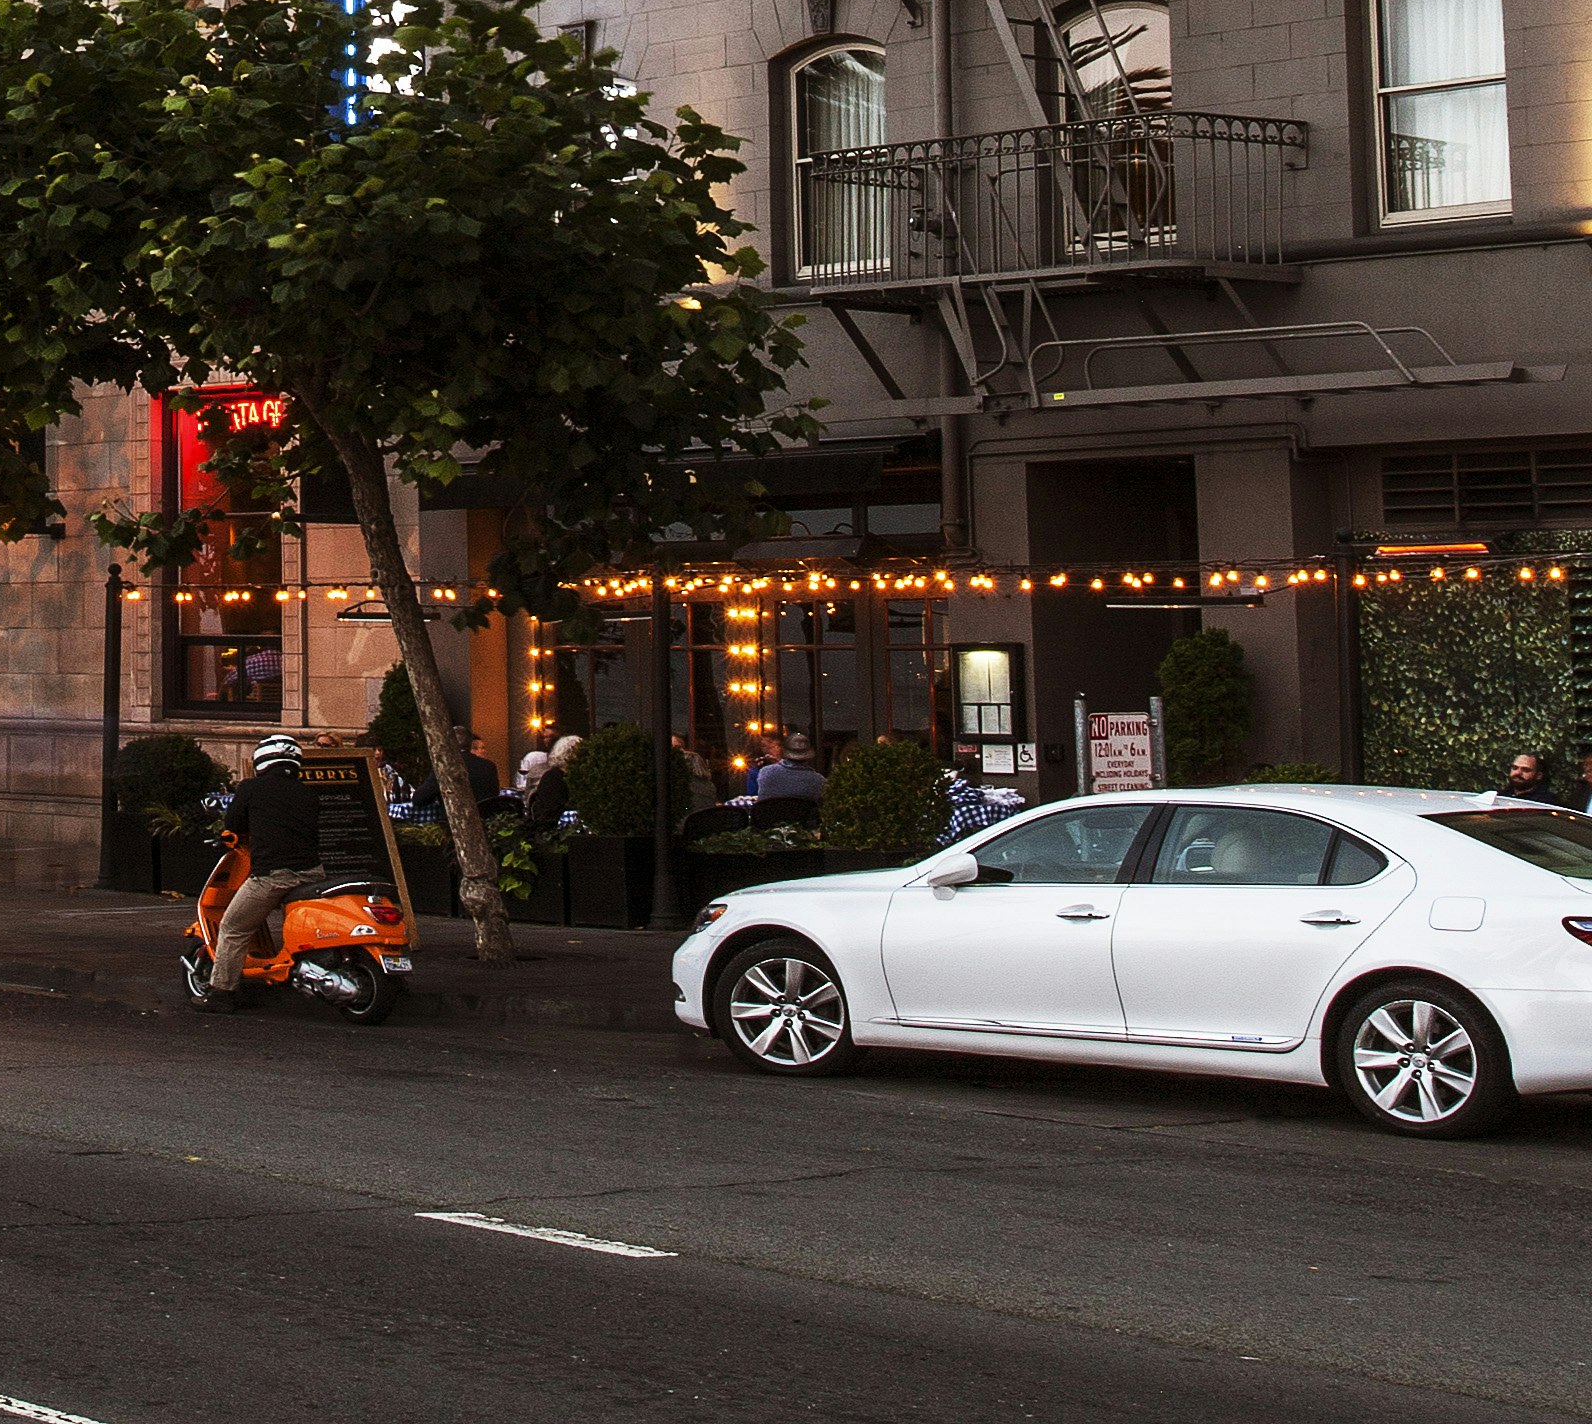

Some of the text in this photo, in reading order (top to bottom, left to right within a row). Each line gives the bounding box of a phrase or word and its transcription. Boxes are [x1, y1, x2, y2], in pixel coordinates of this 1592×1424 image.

[1091, 716, 1147, 737] NO PARKING
[1095, 769, 1148, 778] INCLUDING HOLIDAYS
[1098, 783, 1117, 791] STREET
